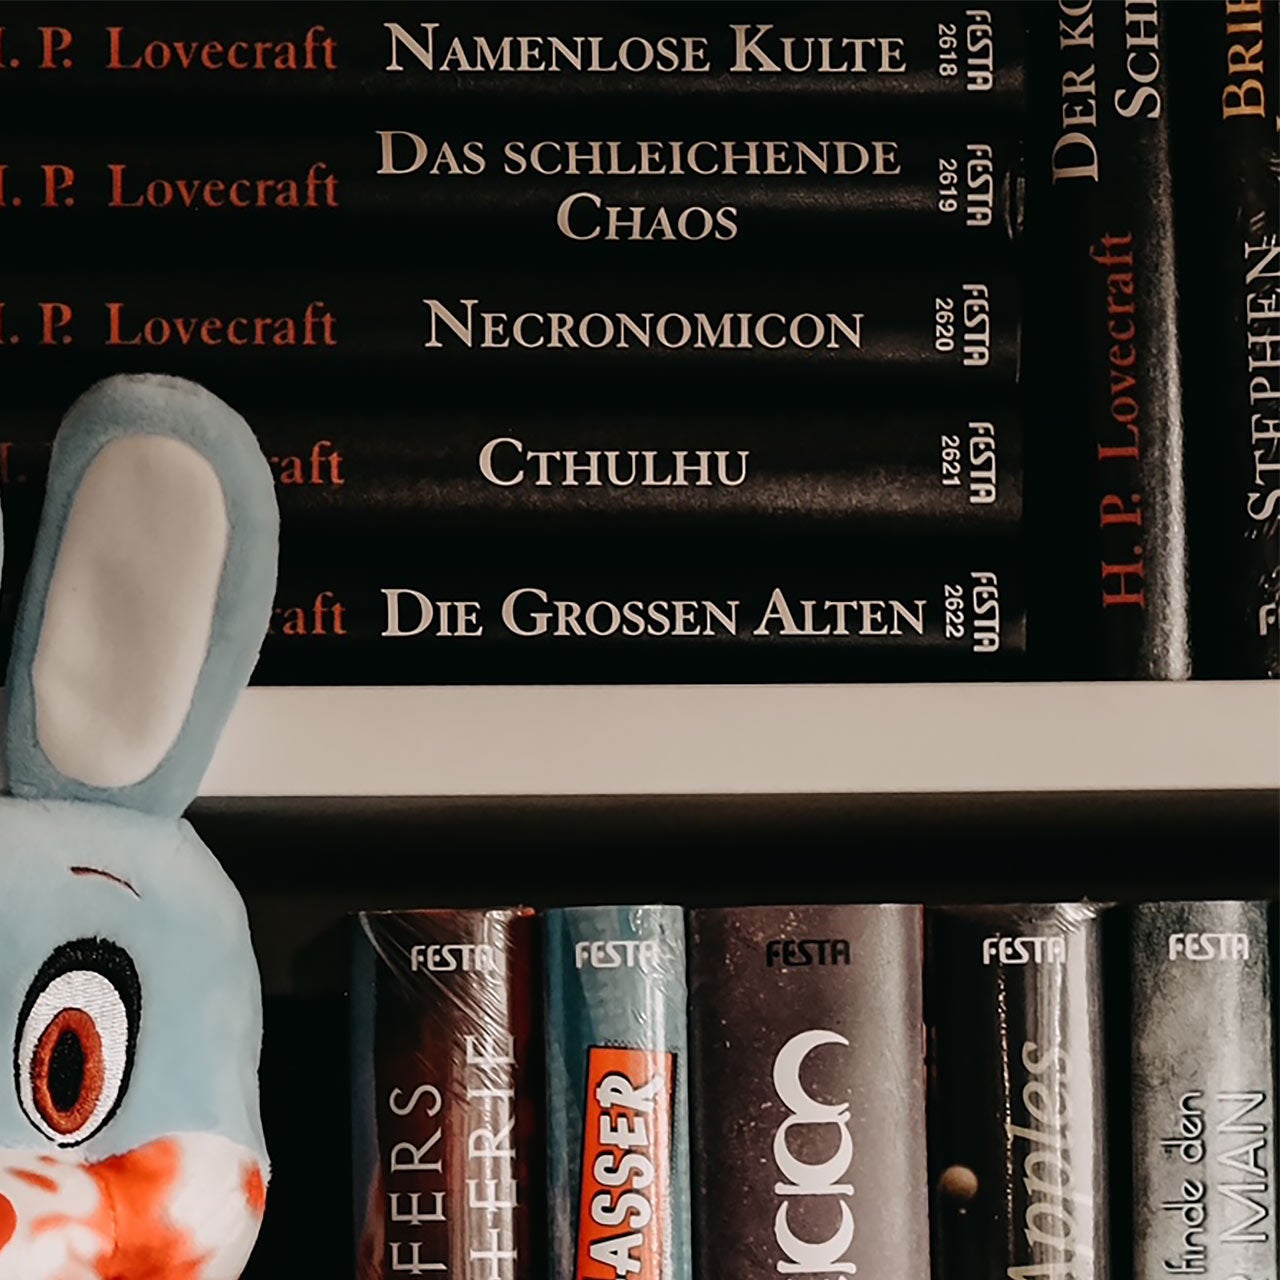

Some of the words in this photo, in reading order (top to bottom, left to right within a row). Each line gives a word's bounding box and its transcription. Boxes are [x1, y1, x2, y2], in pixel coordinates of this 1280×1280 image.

[37, 26, 73, 69] P.
[105, 25, 338, 69] Lovecraft
[383, 22, 711, 72] NAMENLOSE
[730, 24, 907, 72] KULTE
[937, 23, 957, 77] 2618
[965, 9, 993, 91] FESTA
[1051, 62, 1100, 185] DER
[375, 129, 487, 175] DAS
[503, 139, 902, 176] SCHLEICHENDE
[39, 163, 75, 208] P.
[107, 163, 339, 208] Lovecraft
[937, 158, 958, 213] 2619
[965, 143, 994, 227] FESTA
[556, 192, 739, 241] CHAOS
[37, 301, 73, 346] P.
[105, 301, 338, 346] Lovecraft
[423, 298, 864, 350] NECRONOMICON
[934, 297, 955, 353] 2620
[963, 283, 990, 367] FESTA
[1089, 231, 1141, 462] Lovecraft
[1243, 233, 1280, 522] STEPHEN
[478, 437, 750, 488] CTHULHU
[940, 434, 961, 489] 2621
[968, 421, 997, 504] FESTA
[1099, 491, 1142, 528] P.
[1101, 543, 1147, 608] H.
[380, 588, 483, 637] DIE
[501, 586, 740, 638] GROSSEN
[753, 587, 928, 637] ALTEN
[943, 584, 965, 640] 2622
[971, 571, 1000, 653] FESTA
[410, 944, 494, 972] FESTA
[575, 940, 662, 969] FESTA
[765, 938, 851, 967] FESTA
[982, 937, 1066, 965] FESTA
[1168, 933, 1249, 961] FESTA
[1160, 1090, 1207, 1164] den
[1216, 1090, 1269, 1243] MAN
[1162, 1184, 1208, 1275] finde
